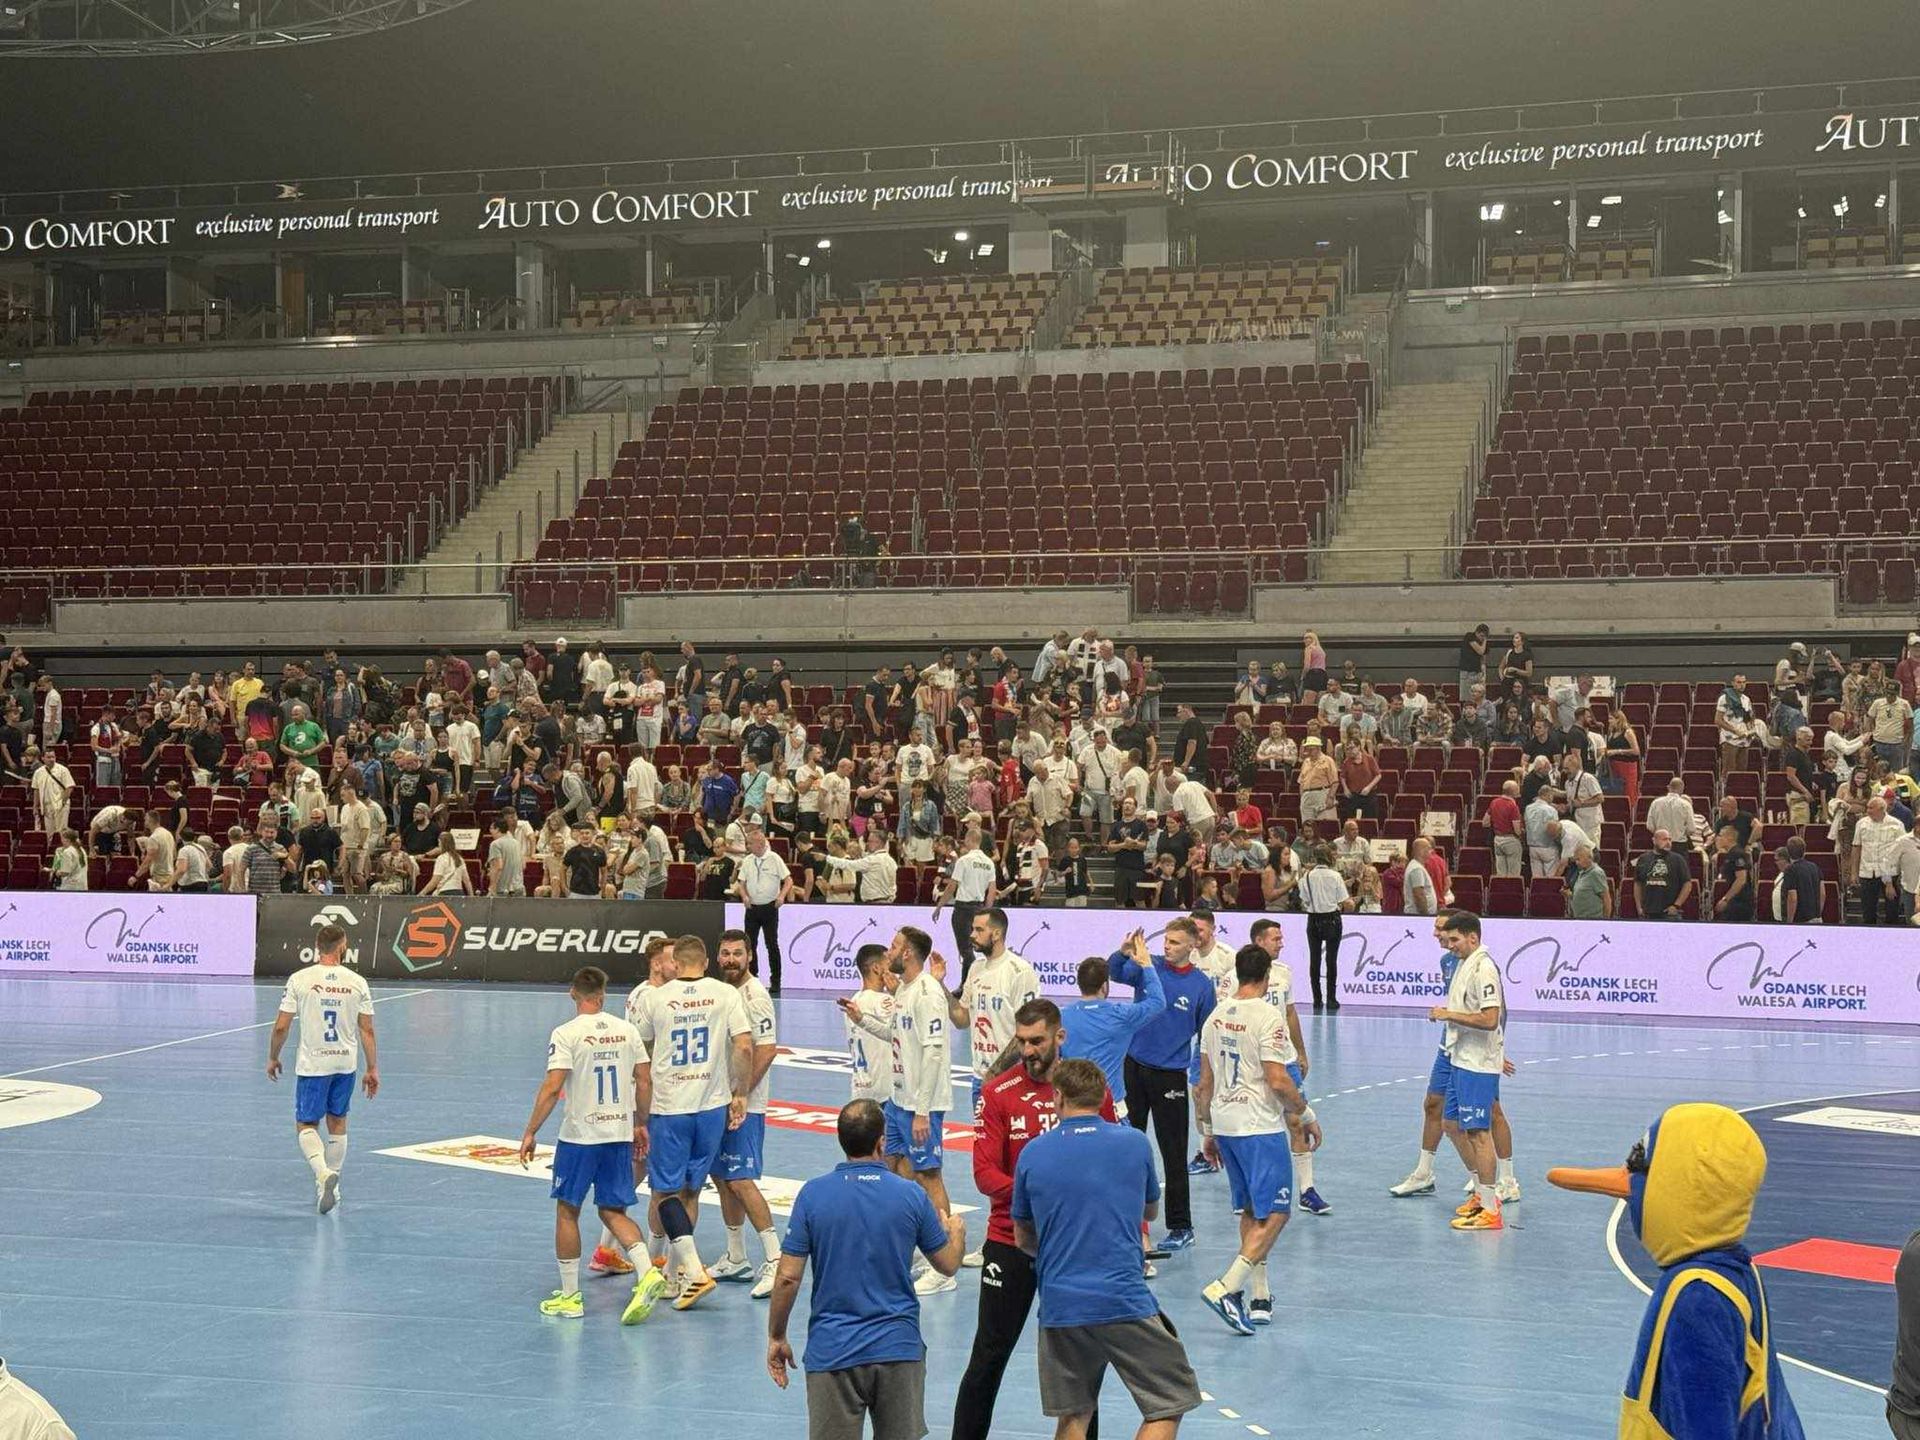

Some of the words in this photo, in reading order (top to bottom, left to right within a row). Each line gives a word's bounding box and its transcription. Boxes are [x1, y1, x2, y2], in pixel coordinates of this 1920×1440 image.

[1816, 113, 1920, 151] AUT
[1446, 141, 1544, 169] exclusive
[1551, 131, 1650, 169] personal
[1656, 129, 1764, 158] transport
[1227, 150, 1418, 189] COMFORT
[781, 182, 867, 209] exclusive
[873, 176, 957, 209] personal
[478, 196, 580, 230] AUTO
[592, 190, 758, 224] COMFORT
[196, 212, 273, 237] exclusive
[278, 207, 353, 238] personal
[357, 207, 440, 233] transport
[25, 218, 175, 250] COMFORT
[26, 940, 51, 950] LECH
[126, 942, 171, 953] GDANSK
[173, 943, 199, 953] LECH
[6, 951, 51, 961] AIRPORT.
[107, 952, 149, 963] WALESA
[152, 953, 199, 965] AIRPORT.
[814, 968, 861, 979] WALESA
[1033, 961, 1059, 972] NSK
[1039, 974, 1076, 986] AIRPO
[1366, 971, 1424, 983] GDANSK
[1427, 973, 1441, 983] LE
[1560, 976, 1620, 989] GDANSK
[1624, 978, 1658, 990] LECH
[325, 986, 352, 995] ORLEN
[1343, 983, 1396, 995] WALESA
[1763, 982, 1827, 995] GDANSK
[1831, 984, 1867, 996] LECH
[1535, 989, 1591, 1001] WALESA
[1596, 990, 1658, 1004] AIRPORT.
[1738, 995, 1797, 1008] WALESA
[1802, 997, 1867, 1010] AIRPORT.
[682, 999, 714, 1009] ORLEN
[324, 1010, 339, 1042] 3
[598, 1035, 626, 1044] ORLEN
[670, 1026, 709, 1066] 33
[593, 1065, 619, 1105] 11
